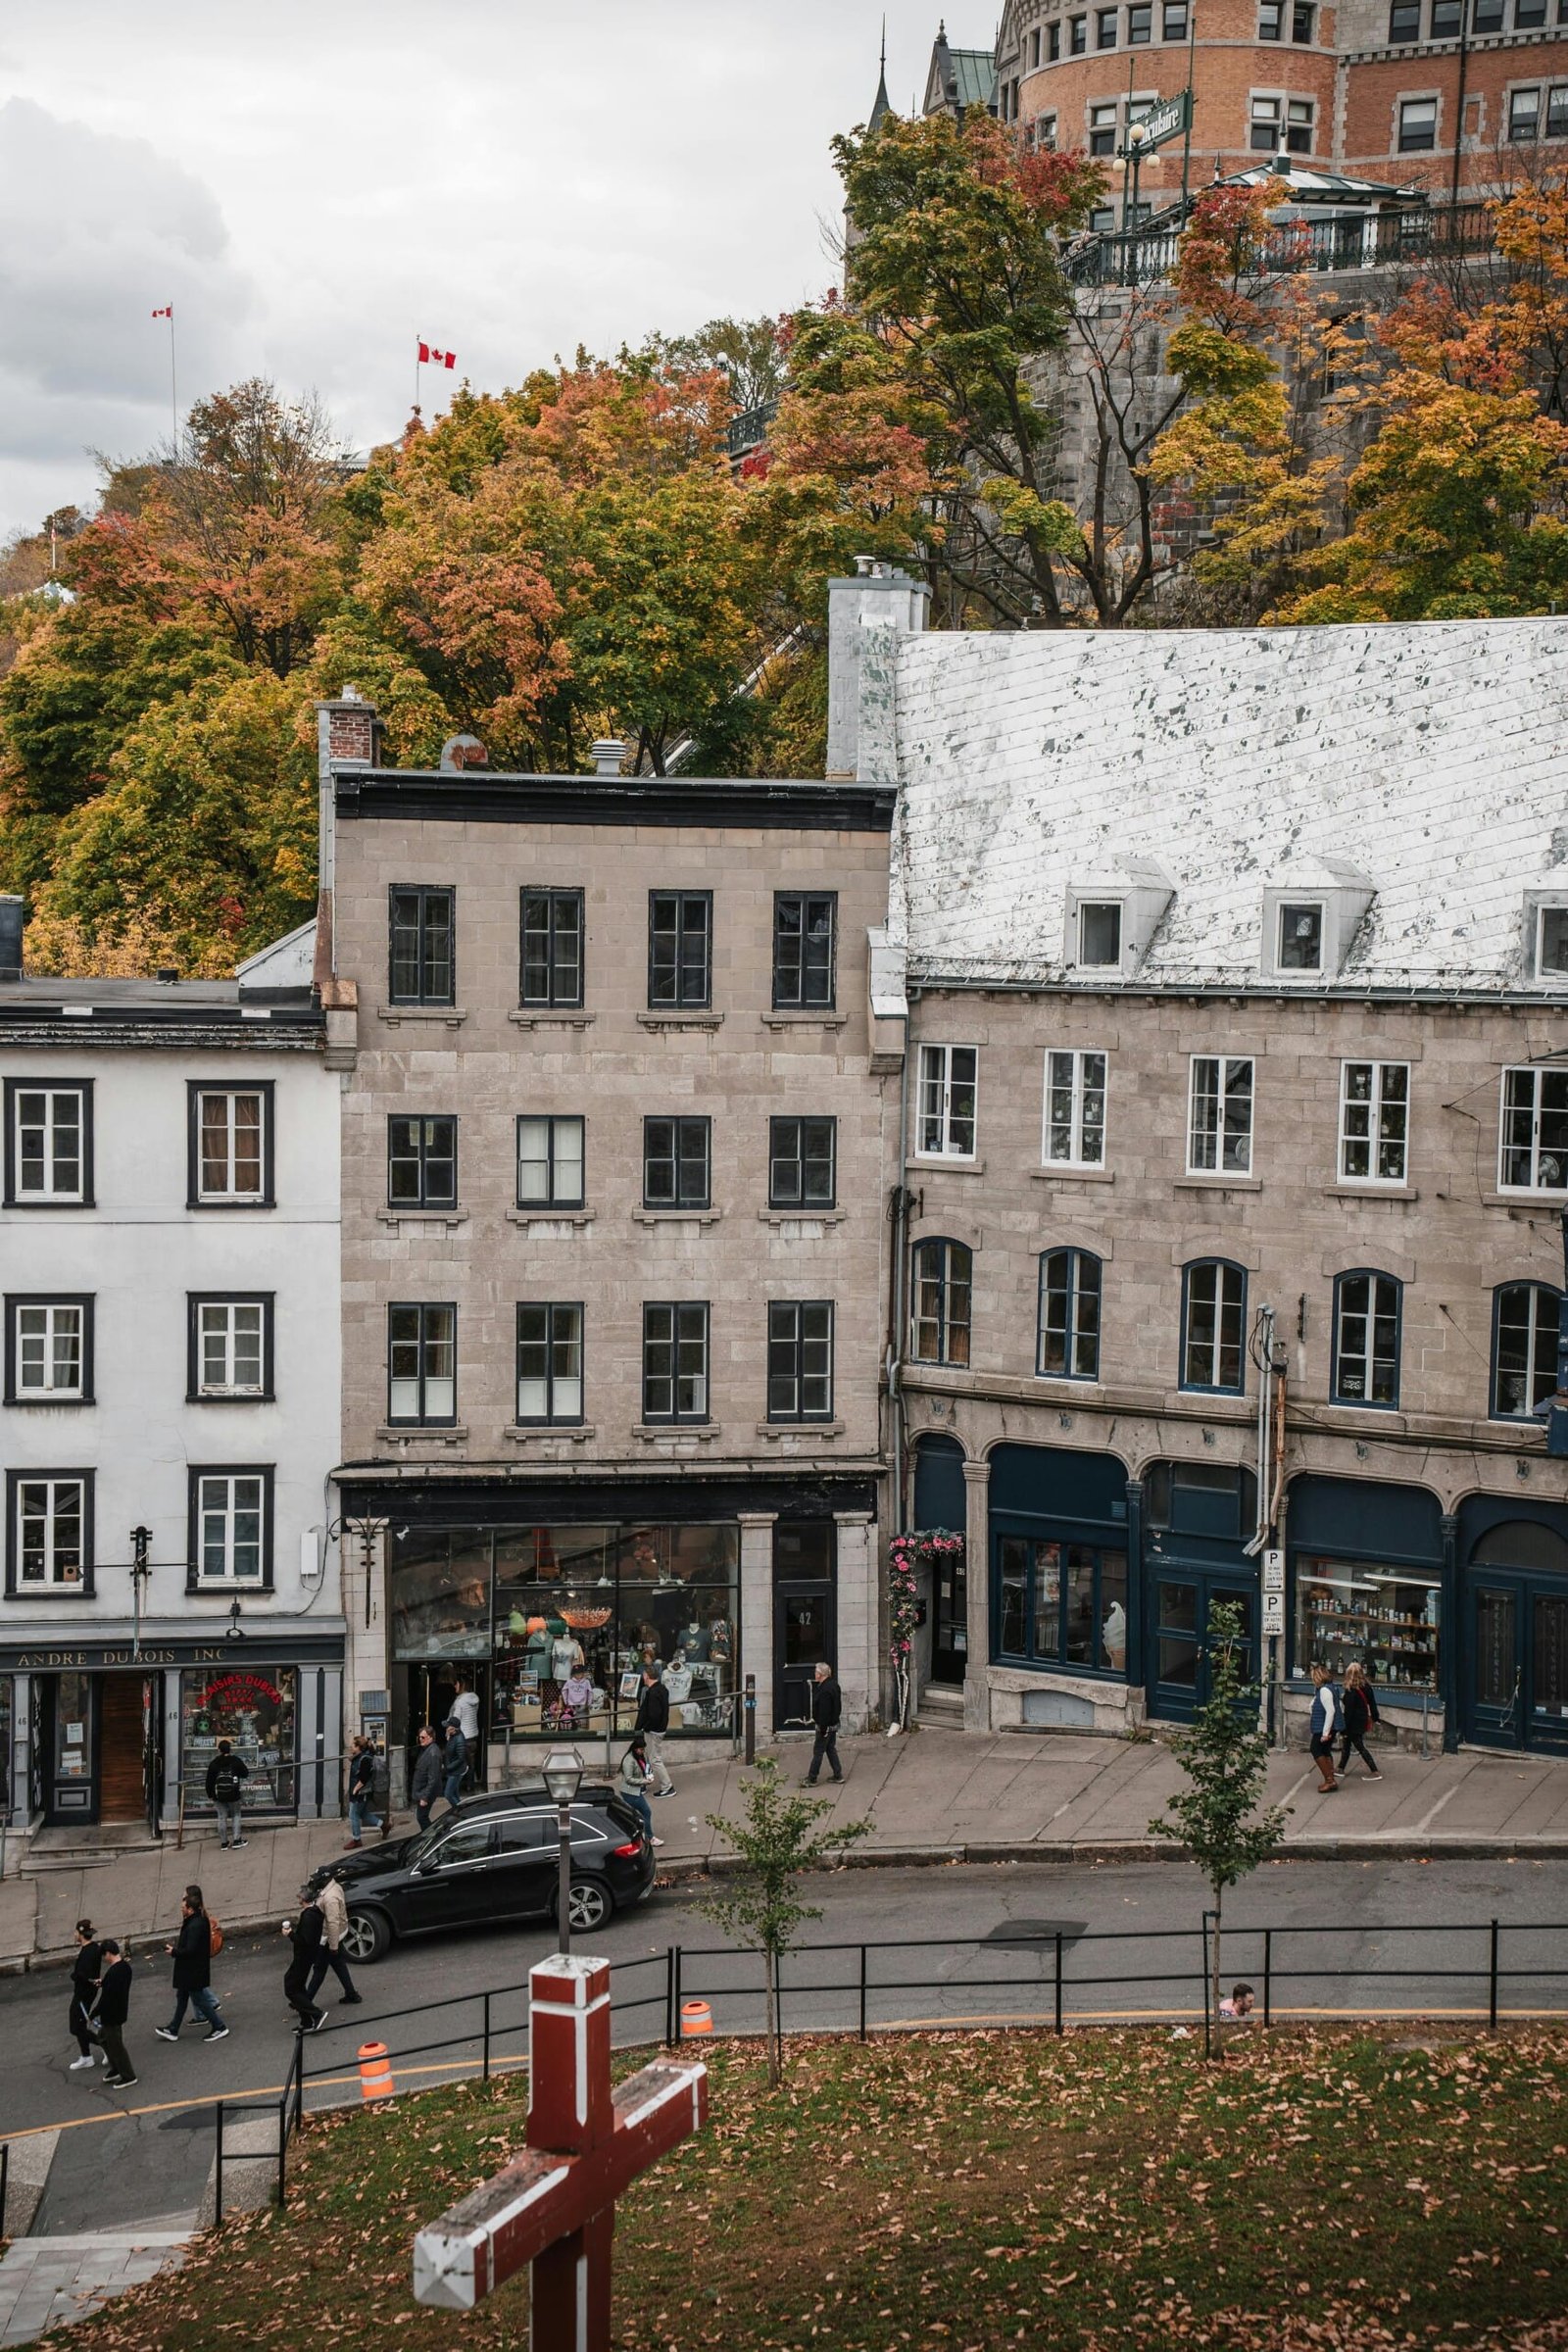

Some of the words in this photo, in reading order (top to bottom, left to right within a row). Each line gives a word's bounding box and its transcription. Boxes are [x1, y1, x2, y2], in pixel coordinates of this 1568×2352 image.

[1129, 107, 1179, 151] iculaire
[1270, 1552, 1278, 1564] P
[1268, 1596, 1278, 1610] P
[799, 1612, 811, 1625] 42
[18, 1652, 86, 1666] ANDRE
[103, 1650, 174, 1664] DUBOIS
[193, 1648, 226, 1661] INC
[244, 1675, 282, 1704] DUBOIS
